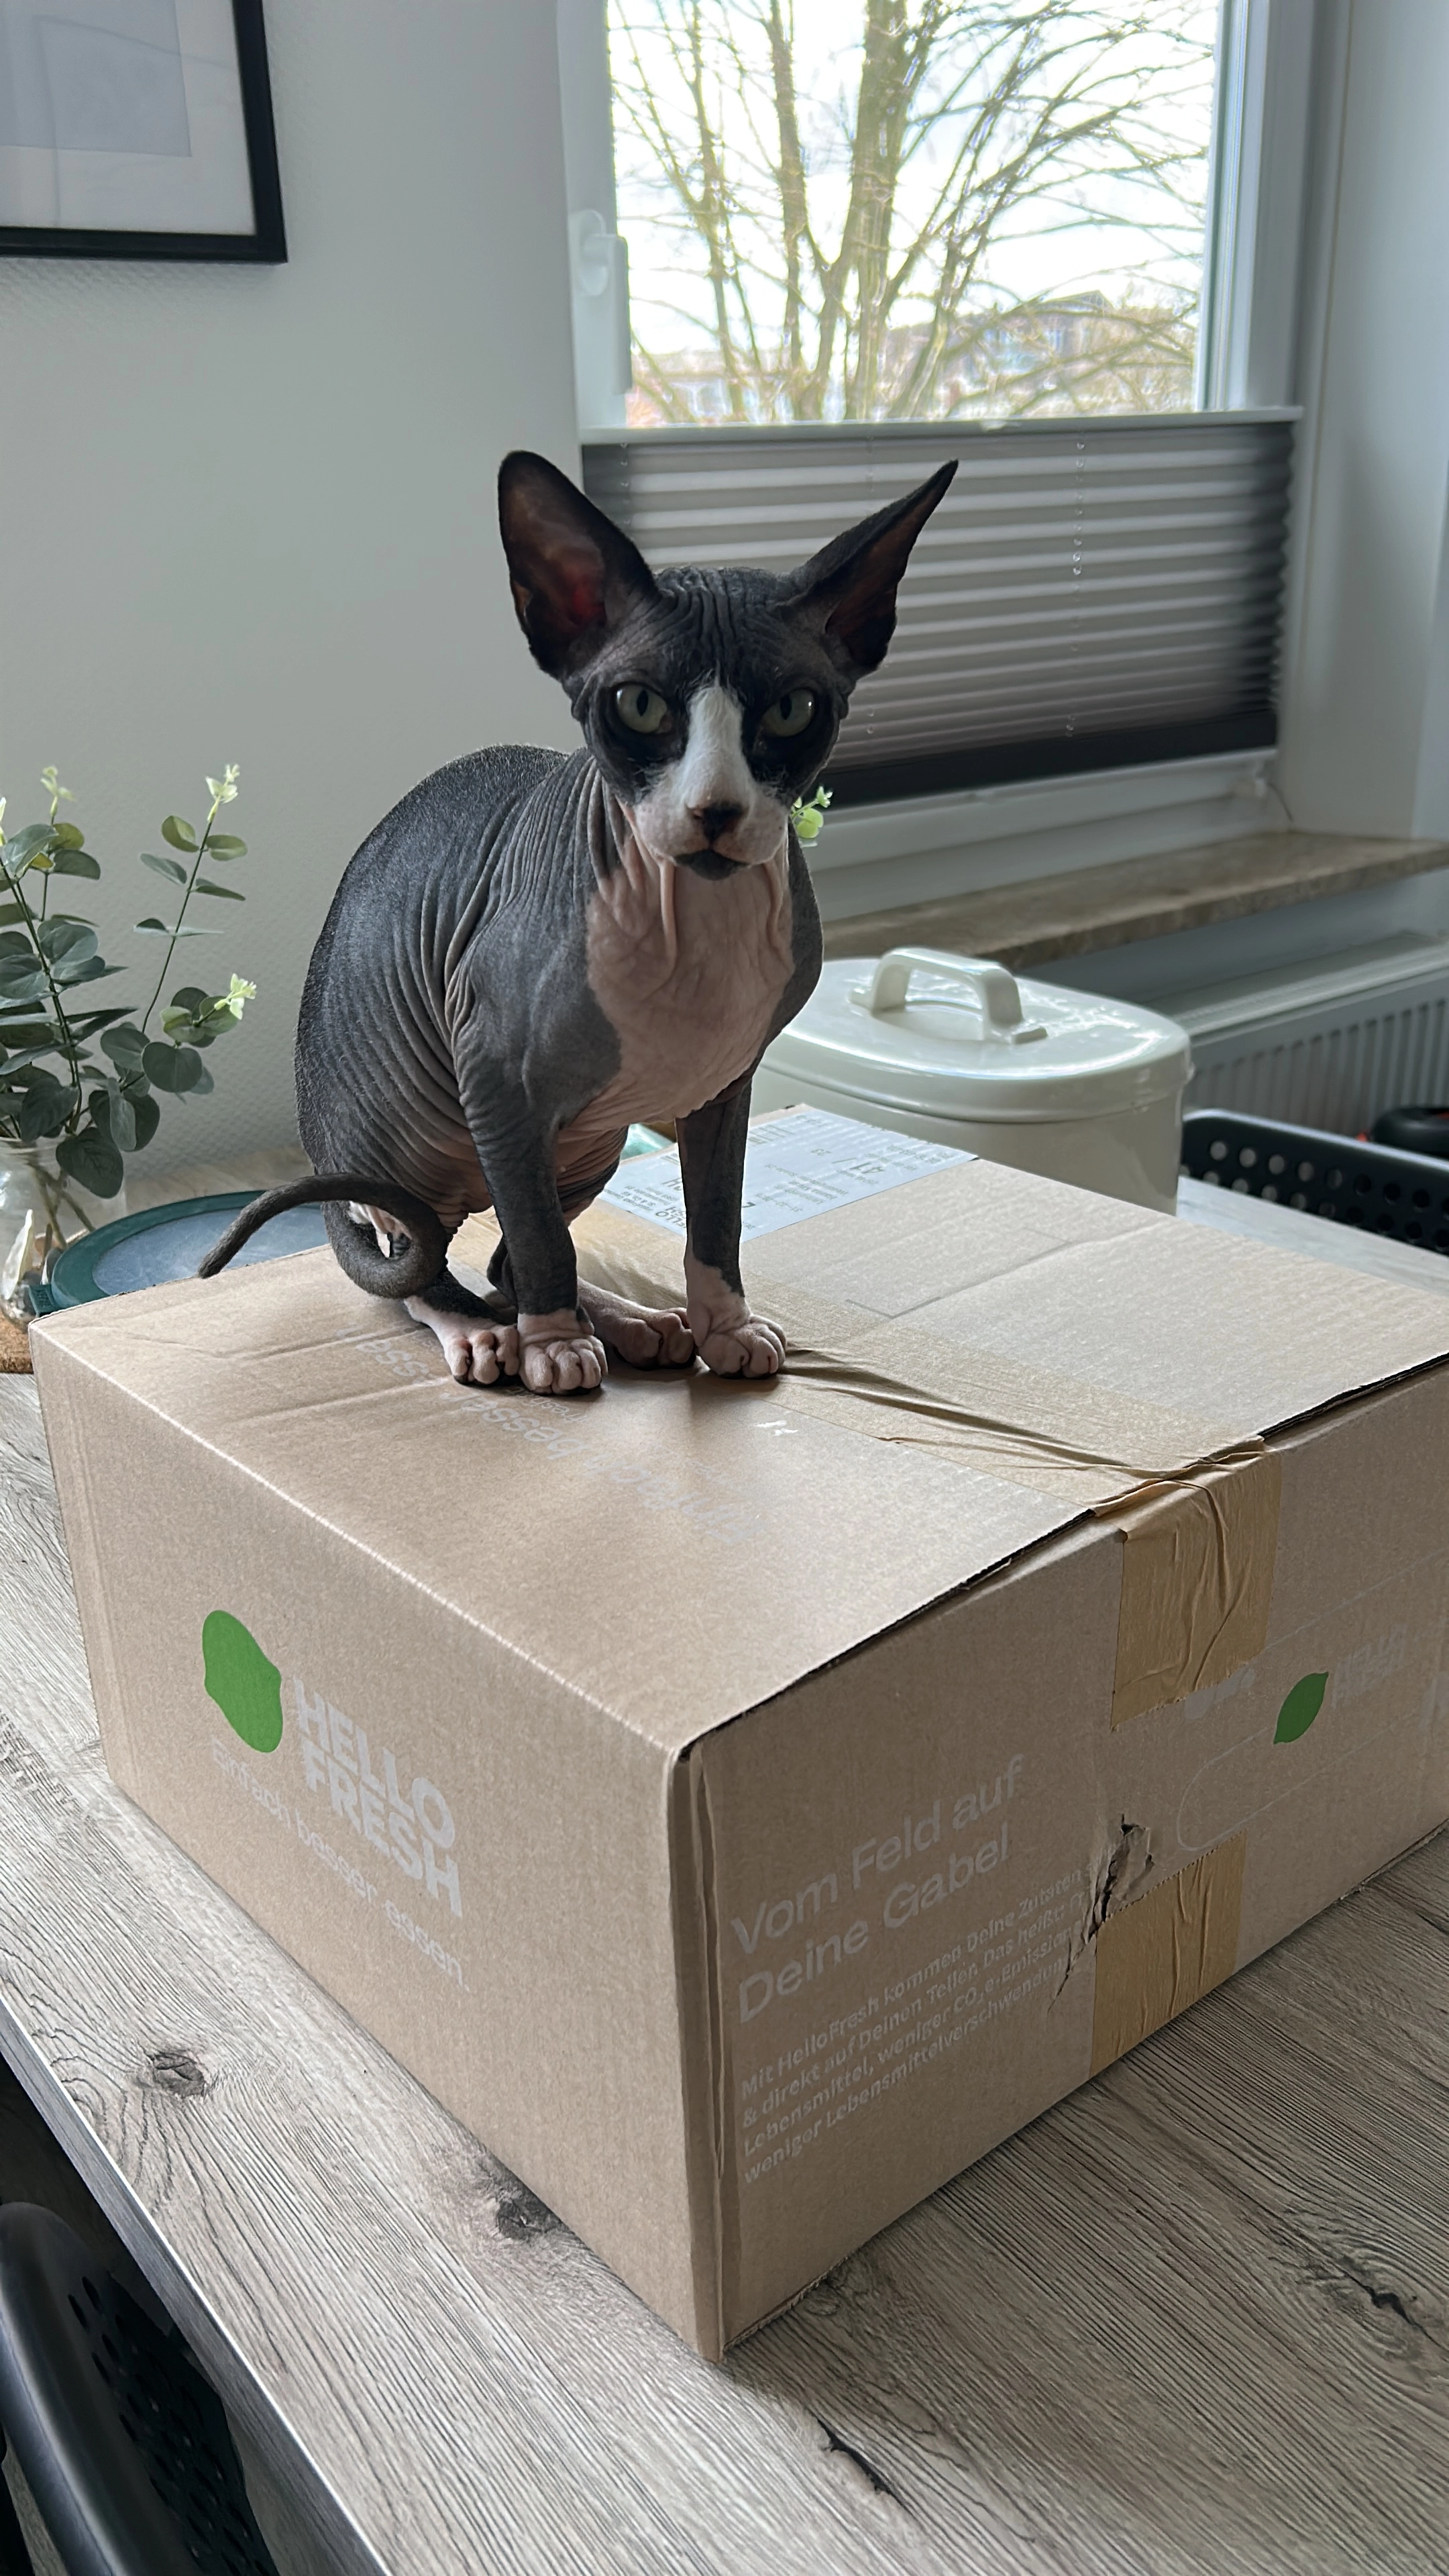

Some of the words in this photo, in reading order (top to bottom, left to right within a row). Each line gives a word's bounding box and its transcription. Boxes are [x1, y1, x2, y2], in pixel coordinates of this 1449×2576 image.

[654, 1210, 687, 1229] ELLO
[849, 1162, 885, 1175] 41
[292, 1675, 455, 1849] HELLO
[303, 1737, 463, 1918] FRESH
[294, 1807, 378, 1903] besser
[731, 1872, 839, 1955] Vom
[851, 1799, 941, 1889] Feld
[951, 1752, 1024, 1831] auf
[739, 1919, 869, 2025] Deine
[883, 1820, 1009, 1930] Gabel
[741, 2064, 773, 2101] Mit
[777, 1996, 880, 2077] HelloFresh
[883, 1944, 962, 2007] kommen
[967, 1912, 1014, 1953] Deine
[1018, 1869, 1081, 1919] Zutaten
[743, 2106, 757, 2129] &
[761, 2063, 820, 2114] direkt
[824, 2035, 856, 2075] auf
[859, 1998, 922, 2051] Deinen
[983, 1938, 1014, 1970] Das
[743, 2055, 874, 2157] Lebensmittel,
[877, 2006, 951, 2064] weniger
[743, 2118, 822, 2184] weniger
